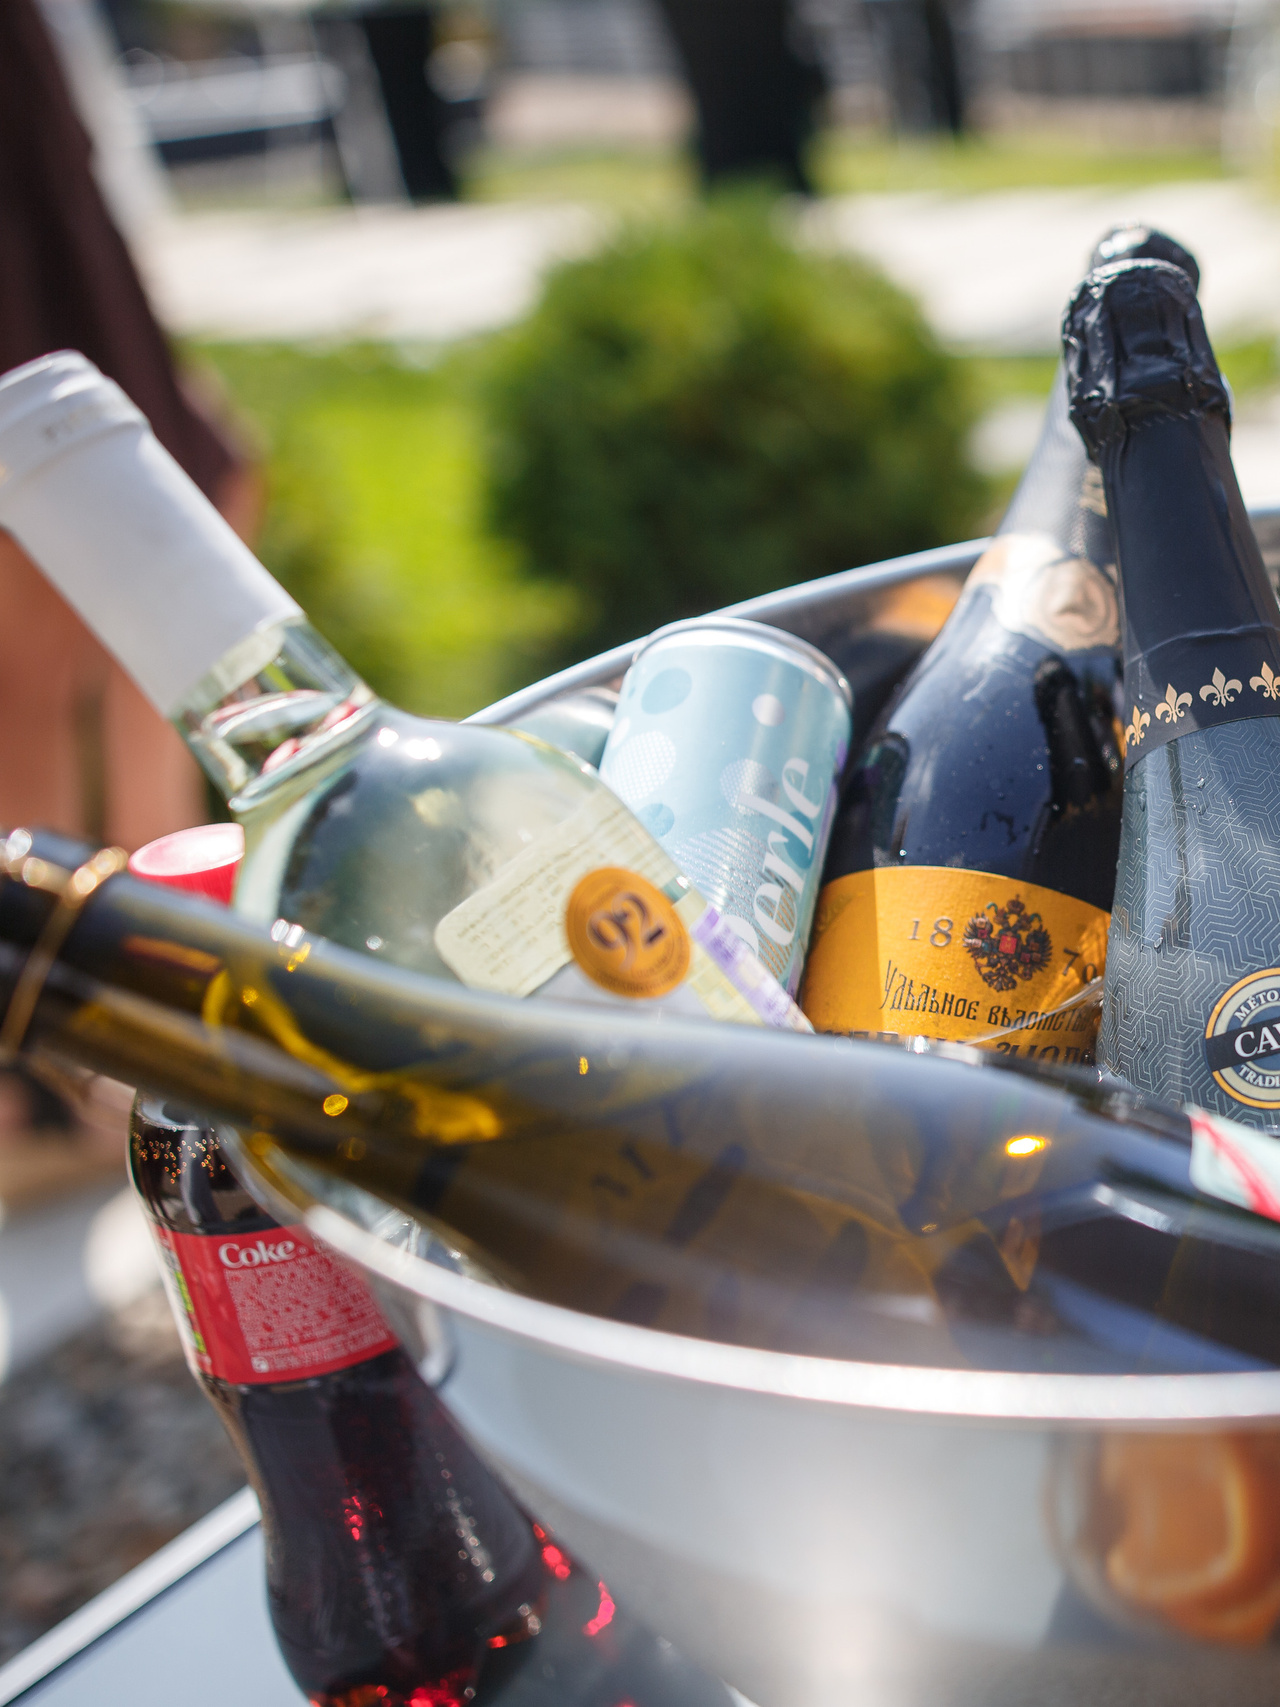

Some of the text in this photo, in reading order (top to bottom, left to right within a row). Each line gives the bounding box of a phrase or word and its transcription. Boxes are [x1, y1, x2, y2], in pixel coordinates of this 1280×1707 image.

[586, 892, 667, 972] 92
[908, 916, 954, 947] 18
[218, 1240, 296, 1269] Coke
